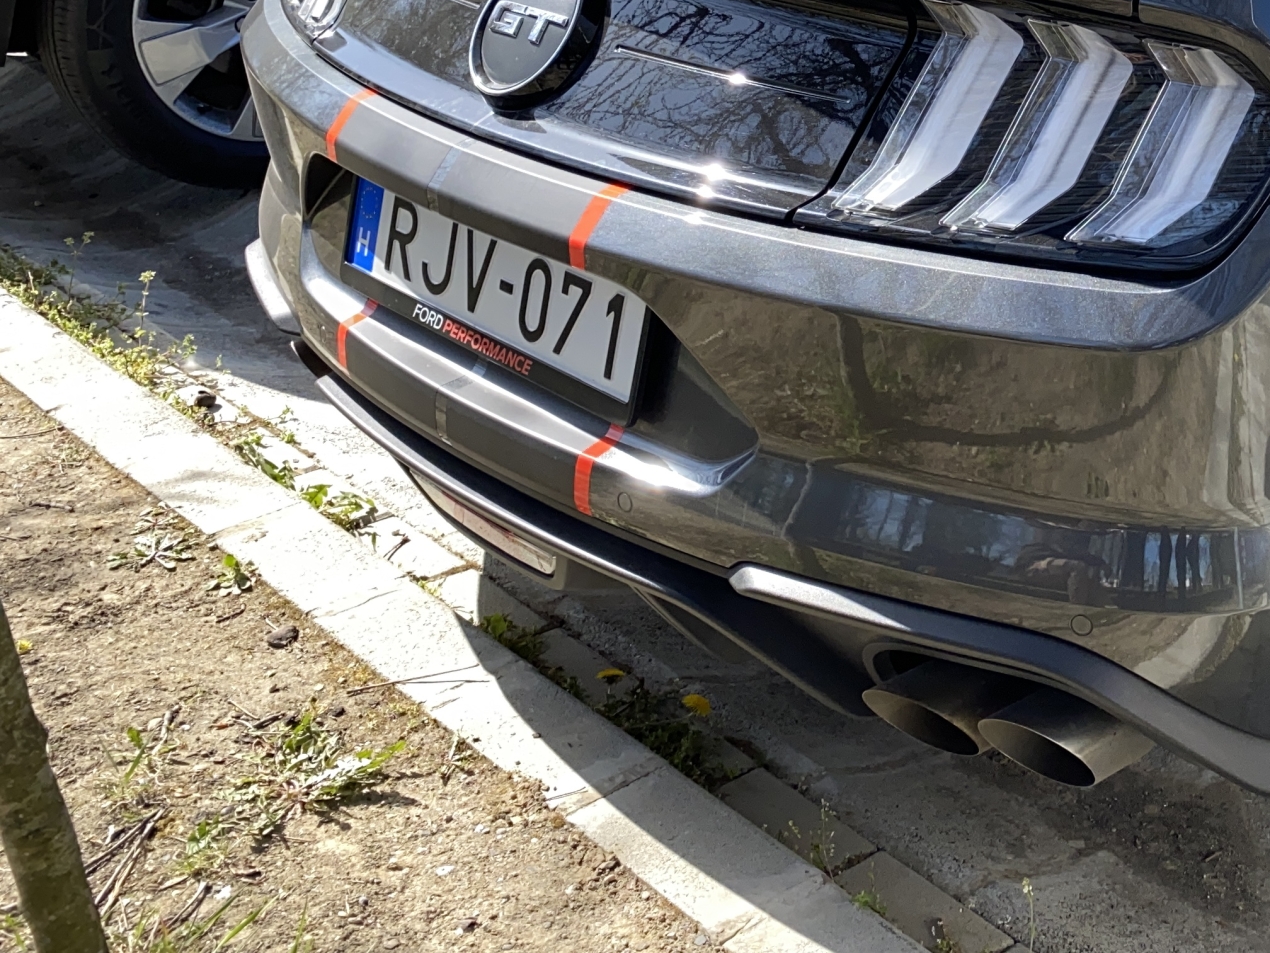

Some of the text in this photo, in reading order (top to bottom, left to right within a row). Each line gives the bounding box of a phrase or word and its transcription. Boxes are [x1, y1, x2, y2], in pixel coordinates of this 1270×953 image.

[489, 0, 570, 46] GT
[356, 226, 372, 257] H
[384, 194, 626, 381] RJV-071
[412, 303, 533, 377] FORD PERFORMANCE
